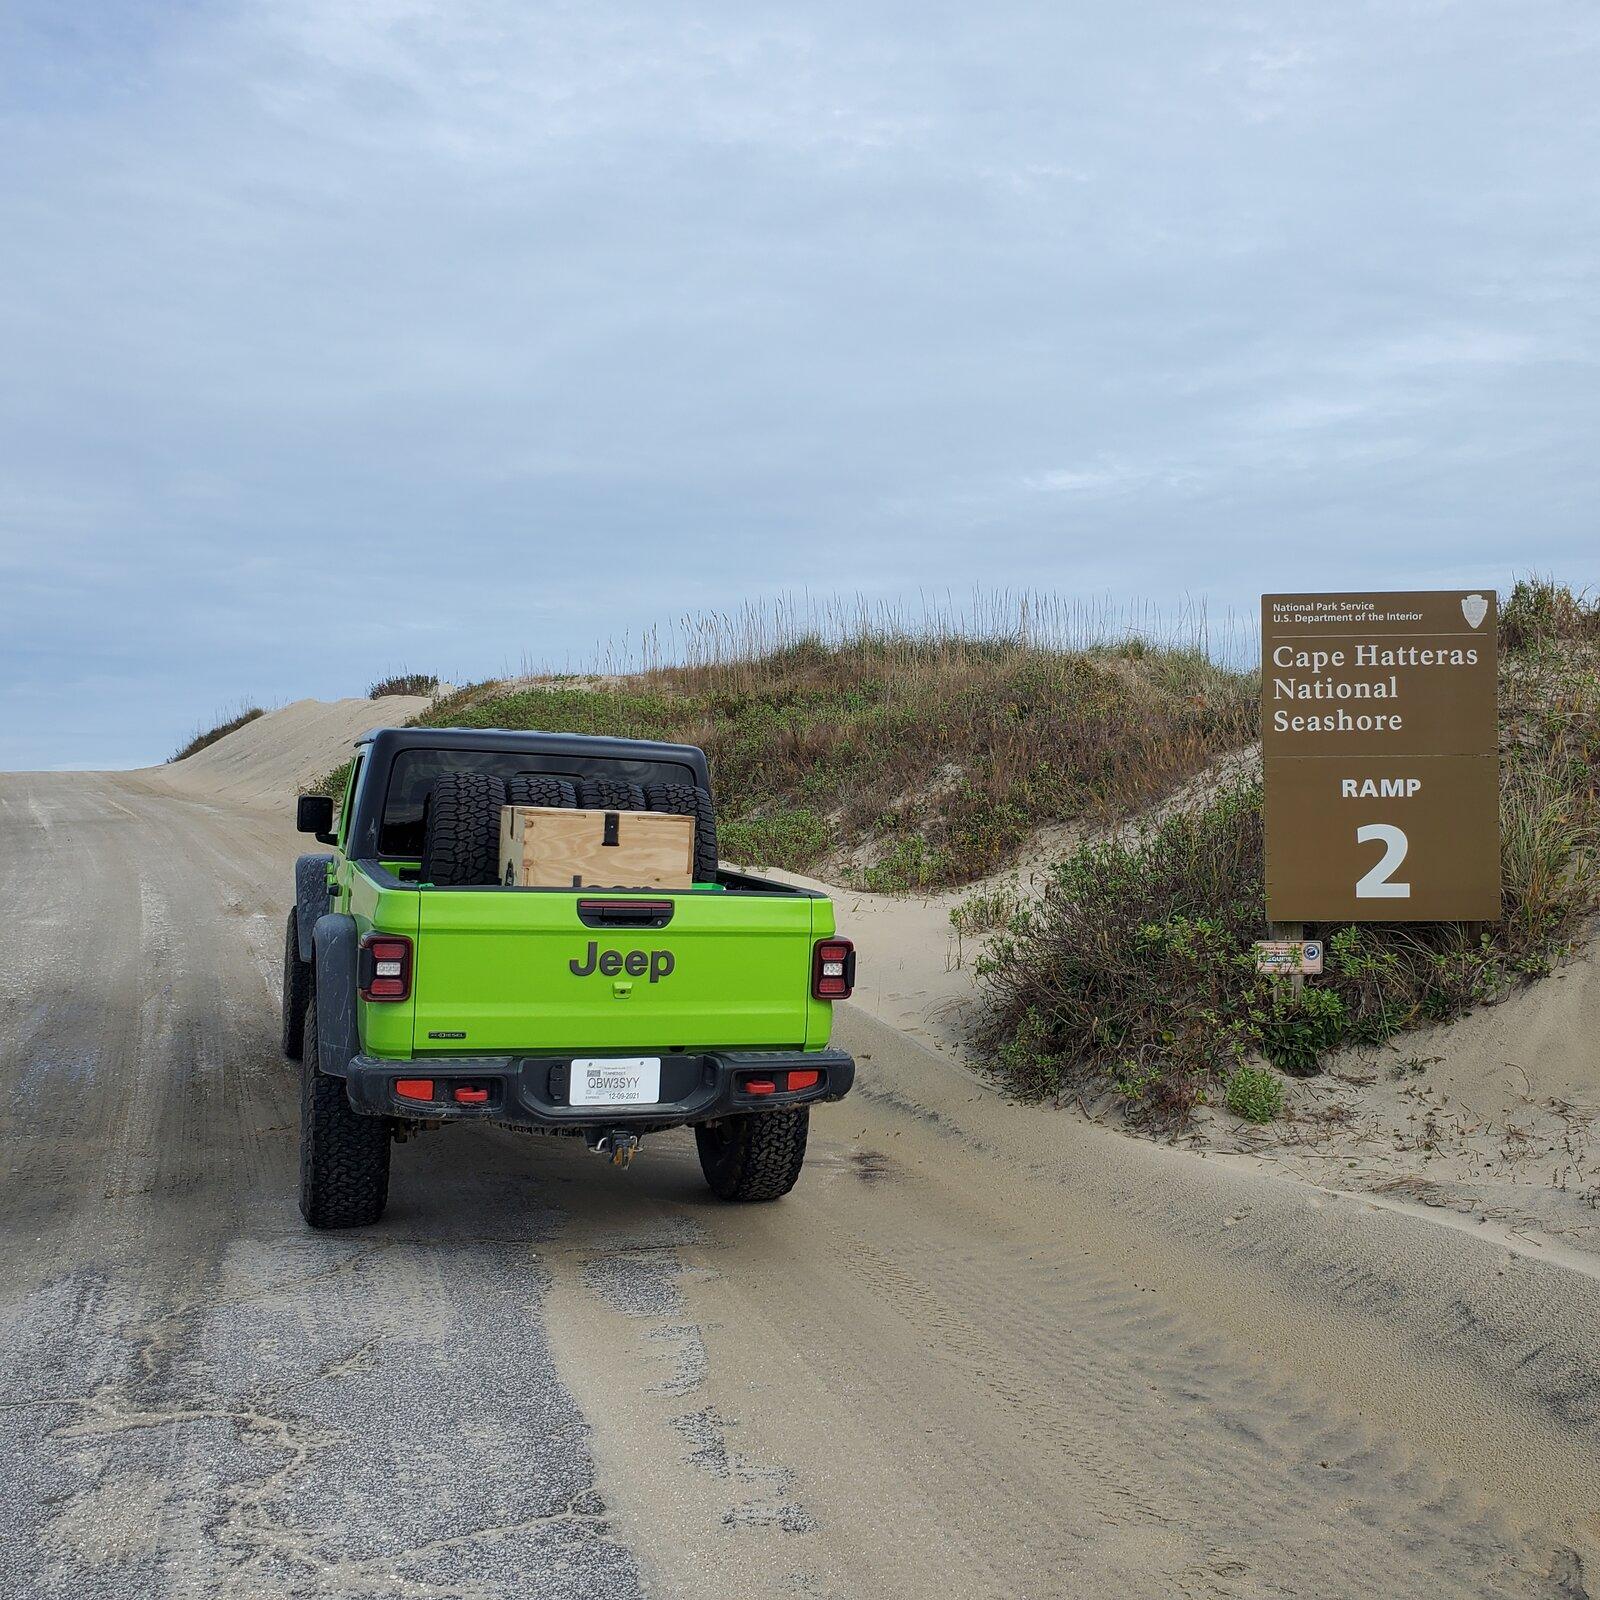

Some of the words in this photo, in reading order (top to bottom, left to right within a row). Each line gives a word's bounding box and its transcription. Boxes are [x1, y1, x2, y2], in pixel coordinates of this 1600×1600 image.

[1273, 603, 1314, 612] National
[1316, 602, 1338, 611] Park
[1340, 601, 1375, 611] Service
[1273, 614, 1292, 623] U.S.
[1294, 613, 1353, 624] Department
[1355, 612, 1366, 621] of
[1367, 612, 1384, 621] the
[1386, 612, 1423, 621] Interior
[1273, 646, 1345, 674] Cape
[1354, 644, 1478, 667] Hatteras
[1273, 676, 1398, 700] National
[1273, 708, 1403, 732] Seashore
[1342, 778, 1422, 798] RAMP
[1355, 823, 1411, 898] 2
[569, 941, 676, 984] Jeep
[588, 1077, 640, 1089] QBW3SYY
